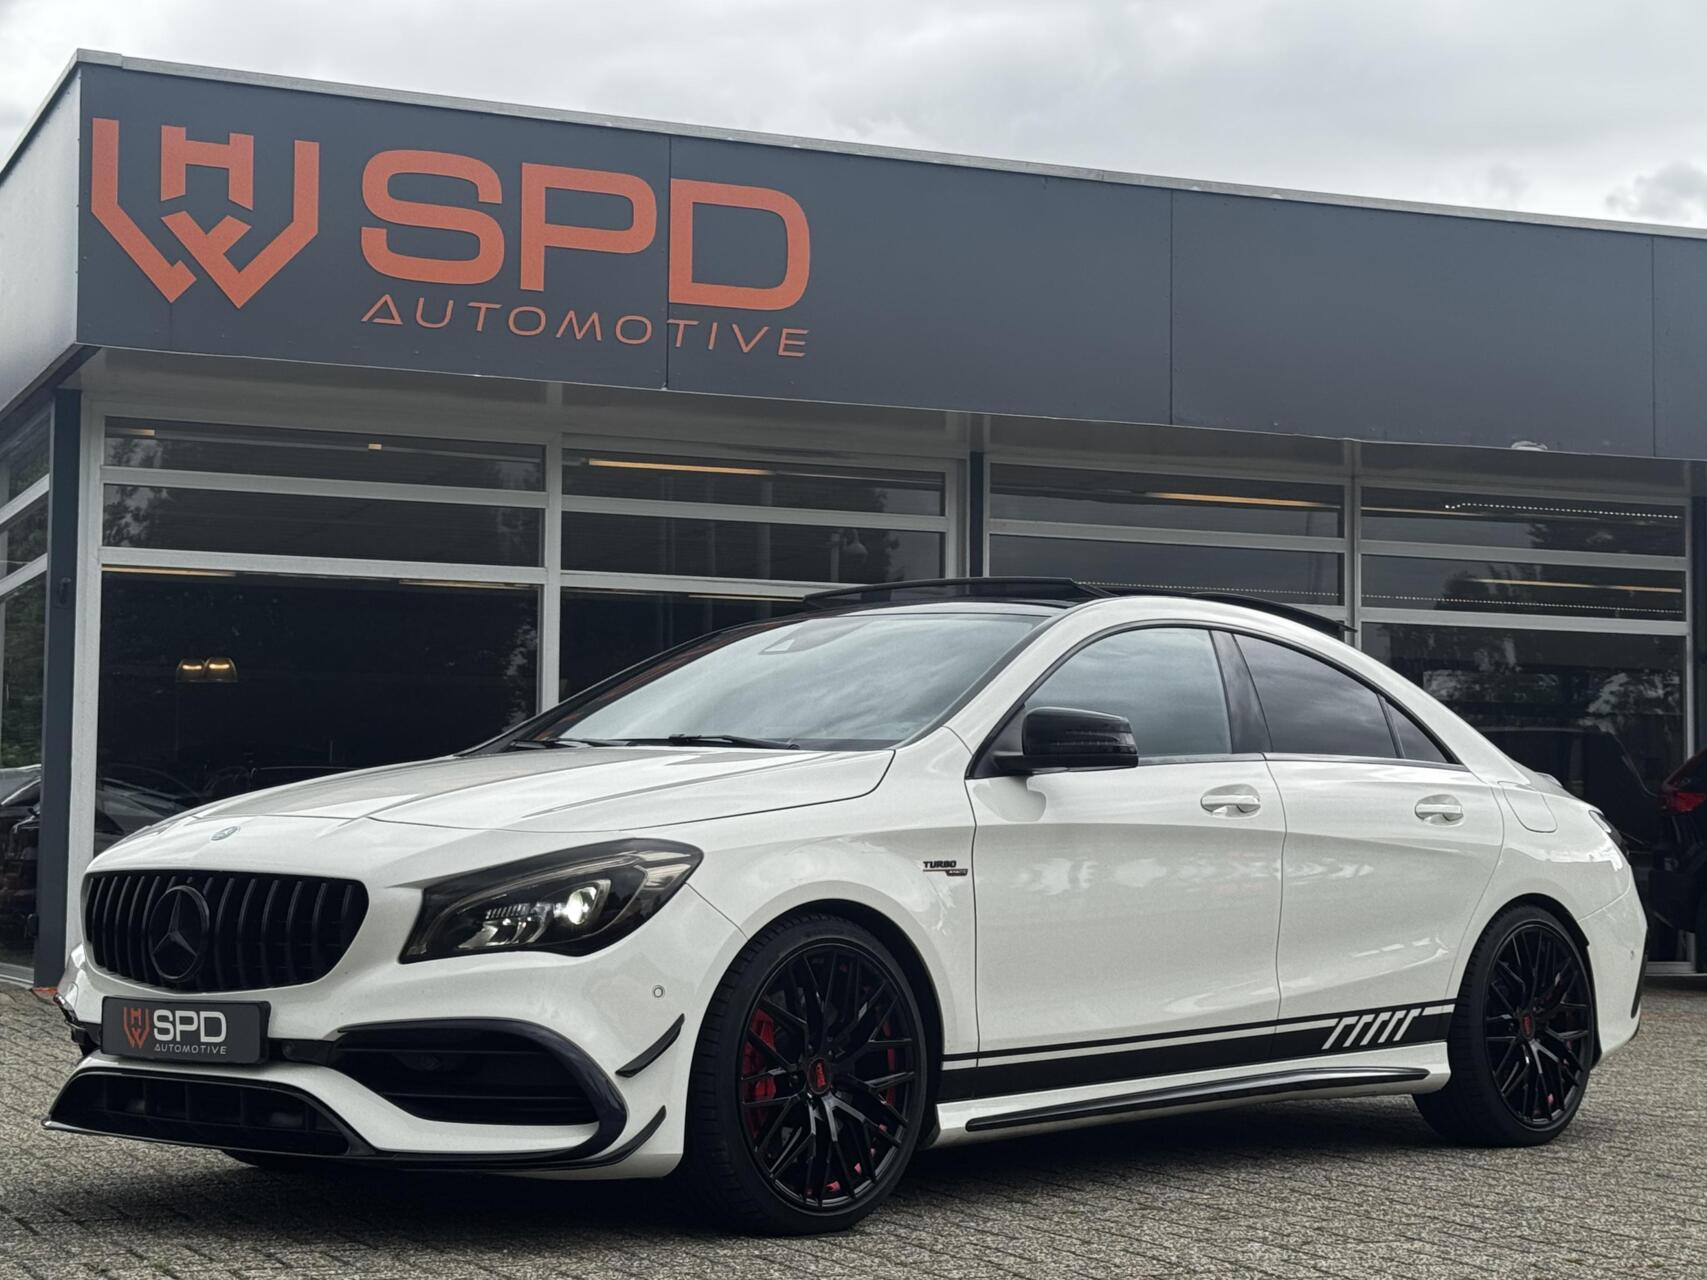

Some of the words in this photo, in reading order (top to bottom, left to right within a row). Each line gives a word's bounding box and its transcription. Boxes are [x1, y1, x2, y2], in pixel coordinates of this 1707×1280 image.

[361, 149, 810, 310] SPD
[360, 294, 810, 357] AUTOMOTIVE
[923, 860, 957, 868] TURBO
[153, 1009, 227, 1043] SPD
[154, 1043, 227, 1055] AUTOMOTIVE
